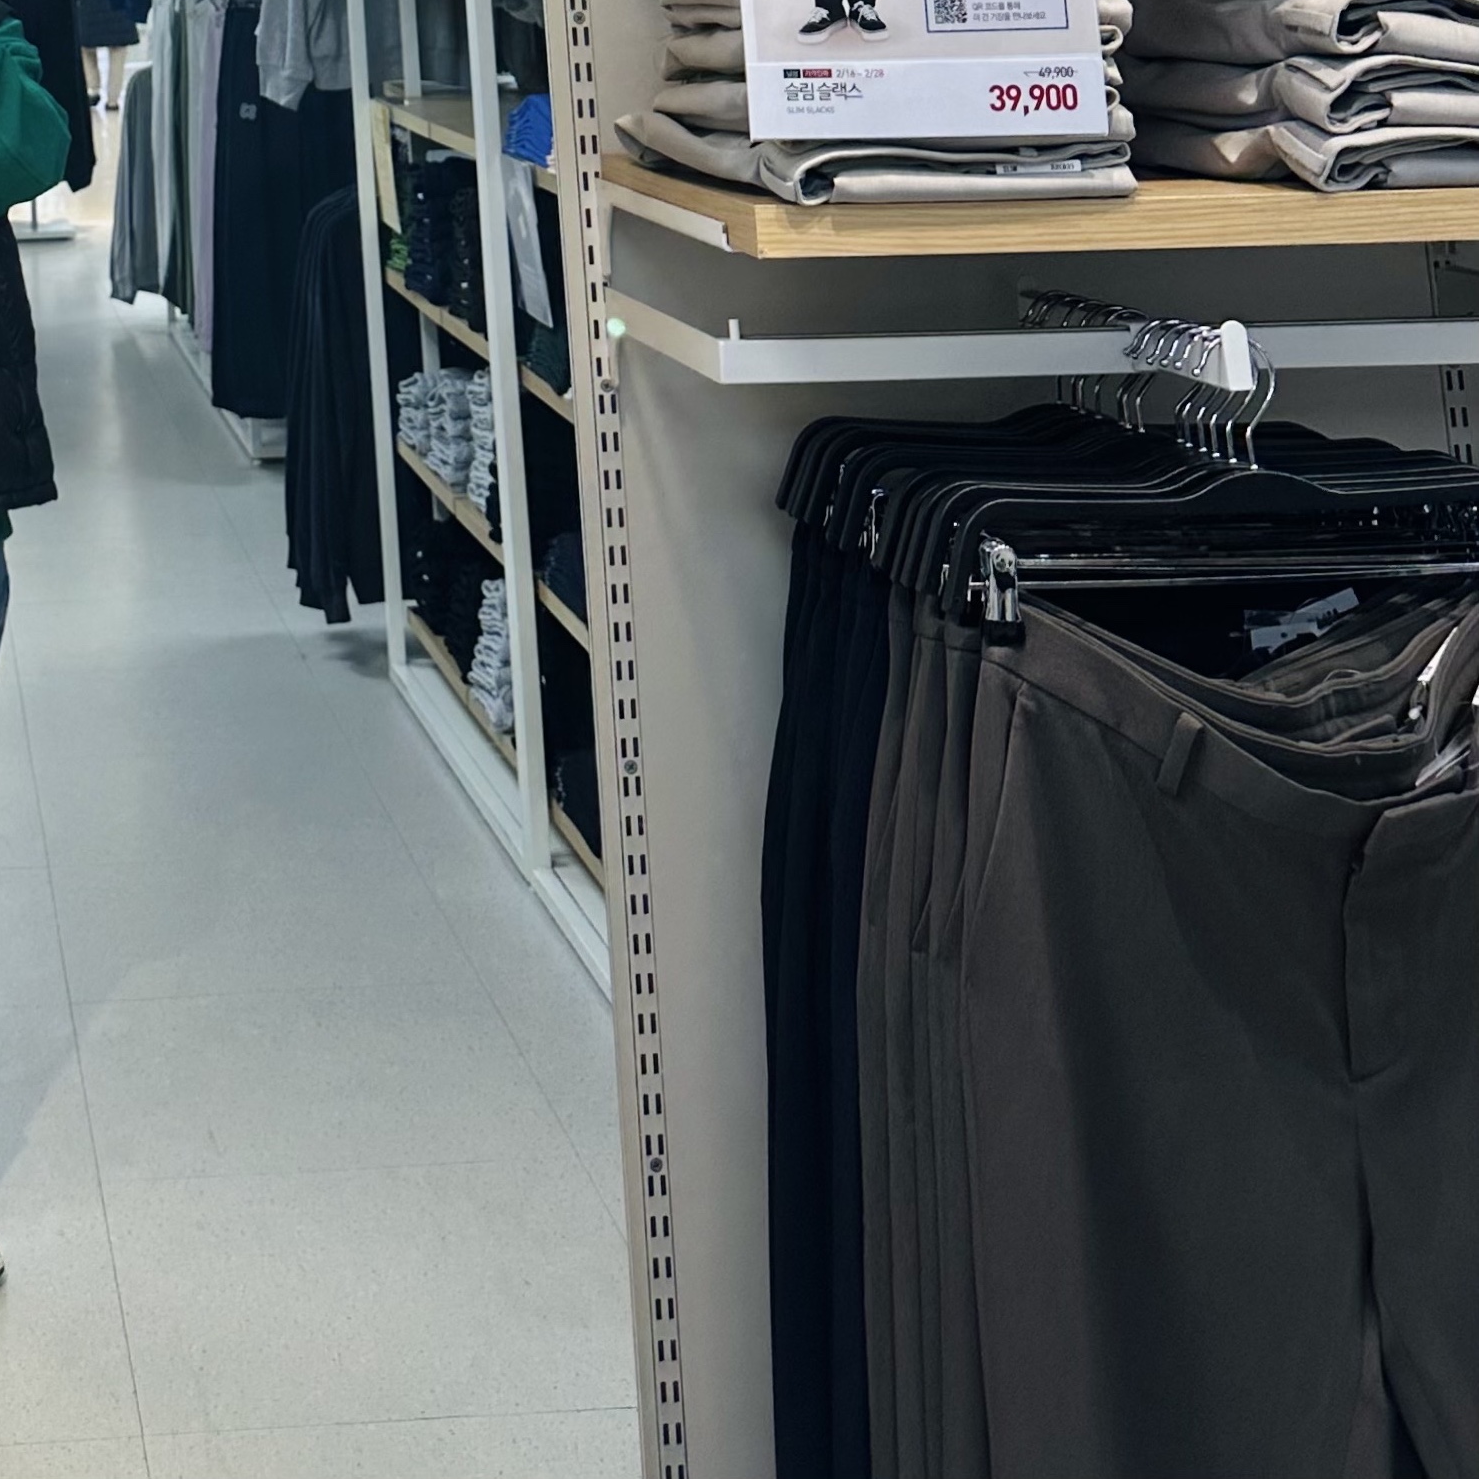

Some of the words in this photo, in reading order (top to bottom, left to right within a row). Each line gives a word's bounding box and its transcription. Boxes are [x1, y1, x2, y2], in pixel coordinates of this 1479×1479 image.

[1038, 66, 1074, 79] 49,900
[784, 82, 814, 101] 슬림
[816, 82, 864, 101] 슬랙스
[989, 83, 1078, 117] 39,900
